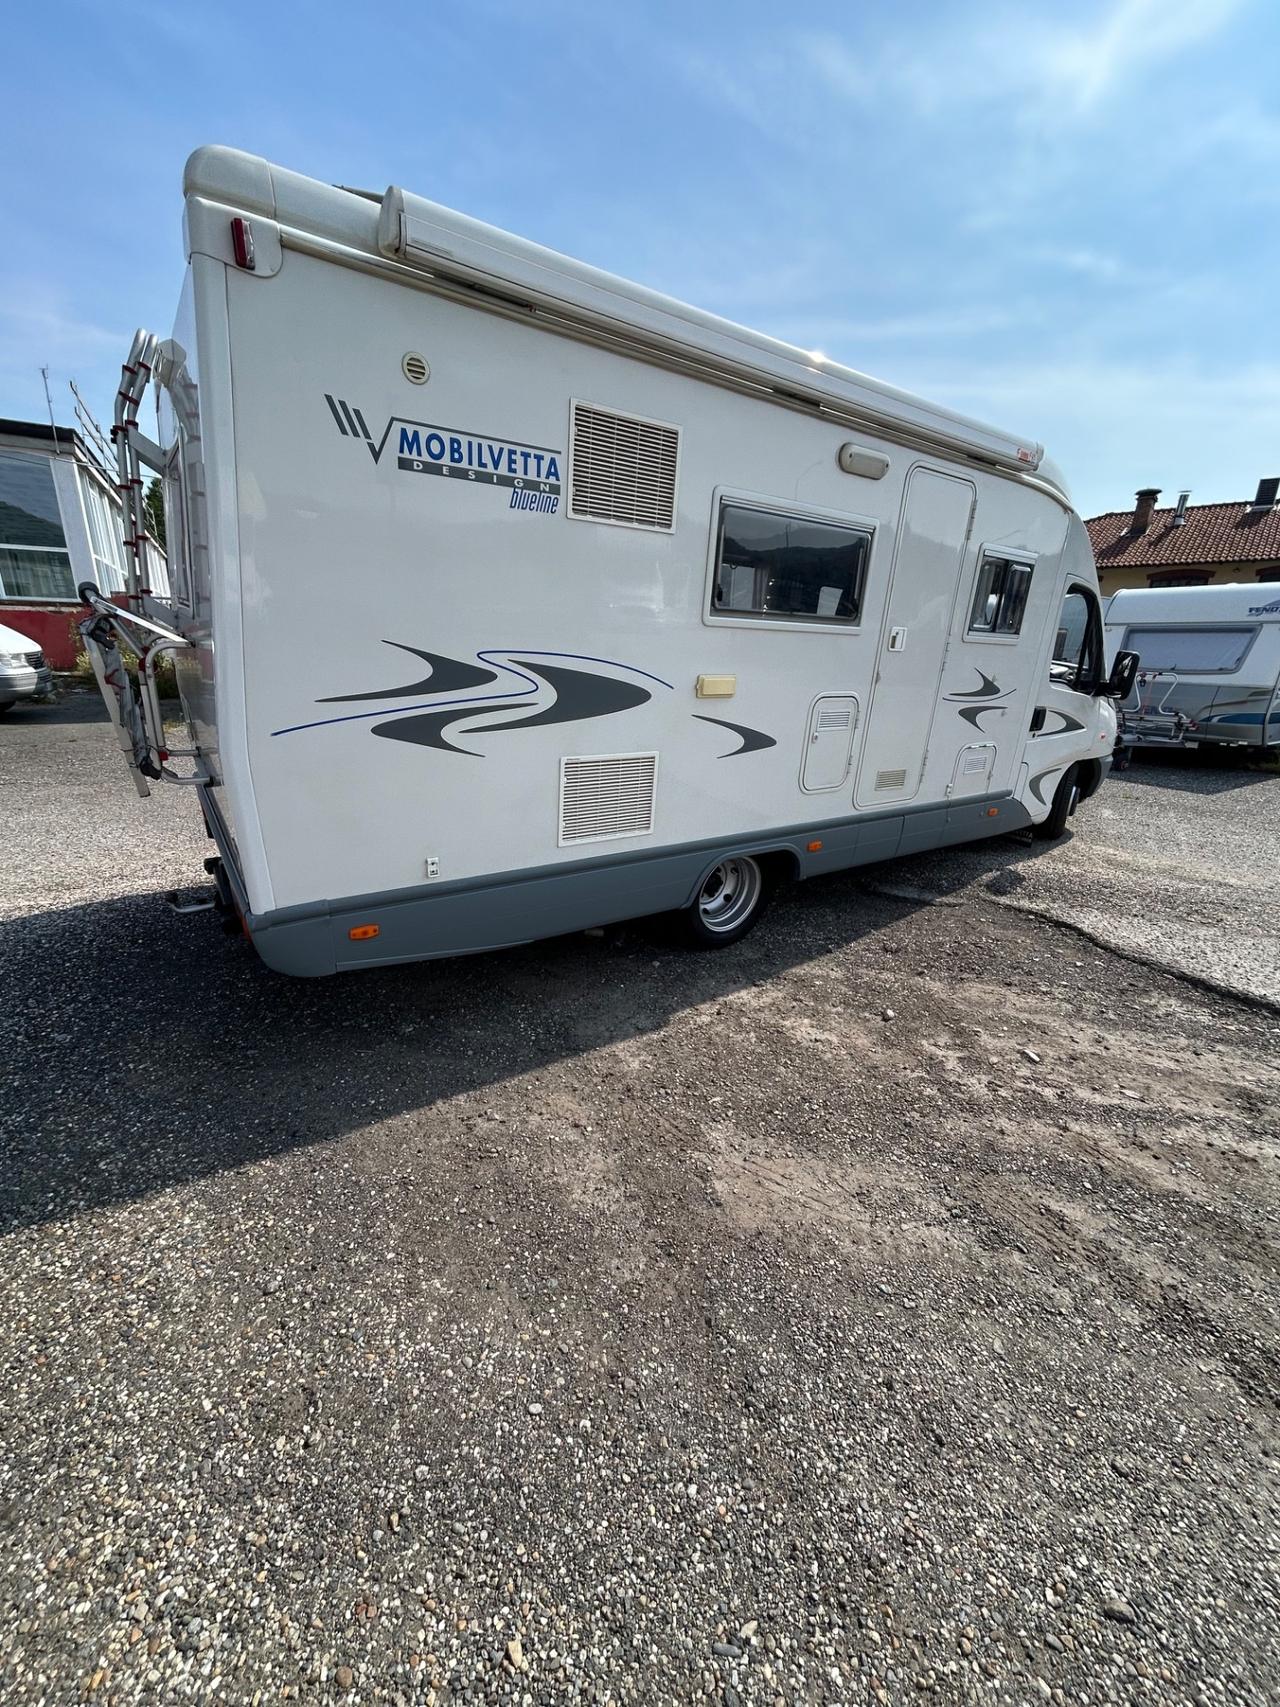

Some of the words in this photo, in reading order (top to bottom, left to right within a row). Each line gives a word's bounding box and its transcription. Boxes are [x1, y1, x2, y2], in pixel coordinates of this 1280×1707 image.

[399, 427, 560, 481] MOBILVETTA
[413, 461, 549, 491] DESIGN
[509, 488, 559, 514] blueline
